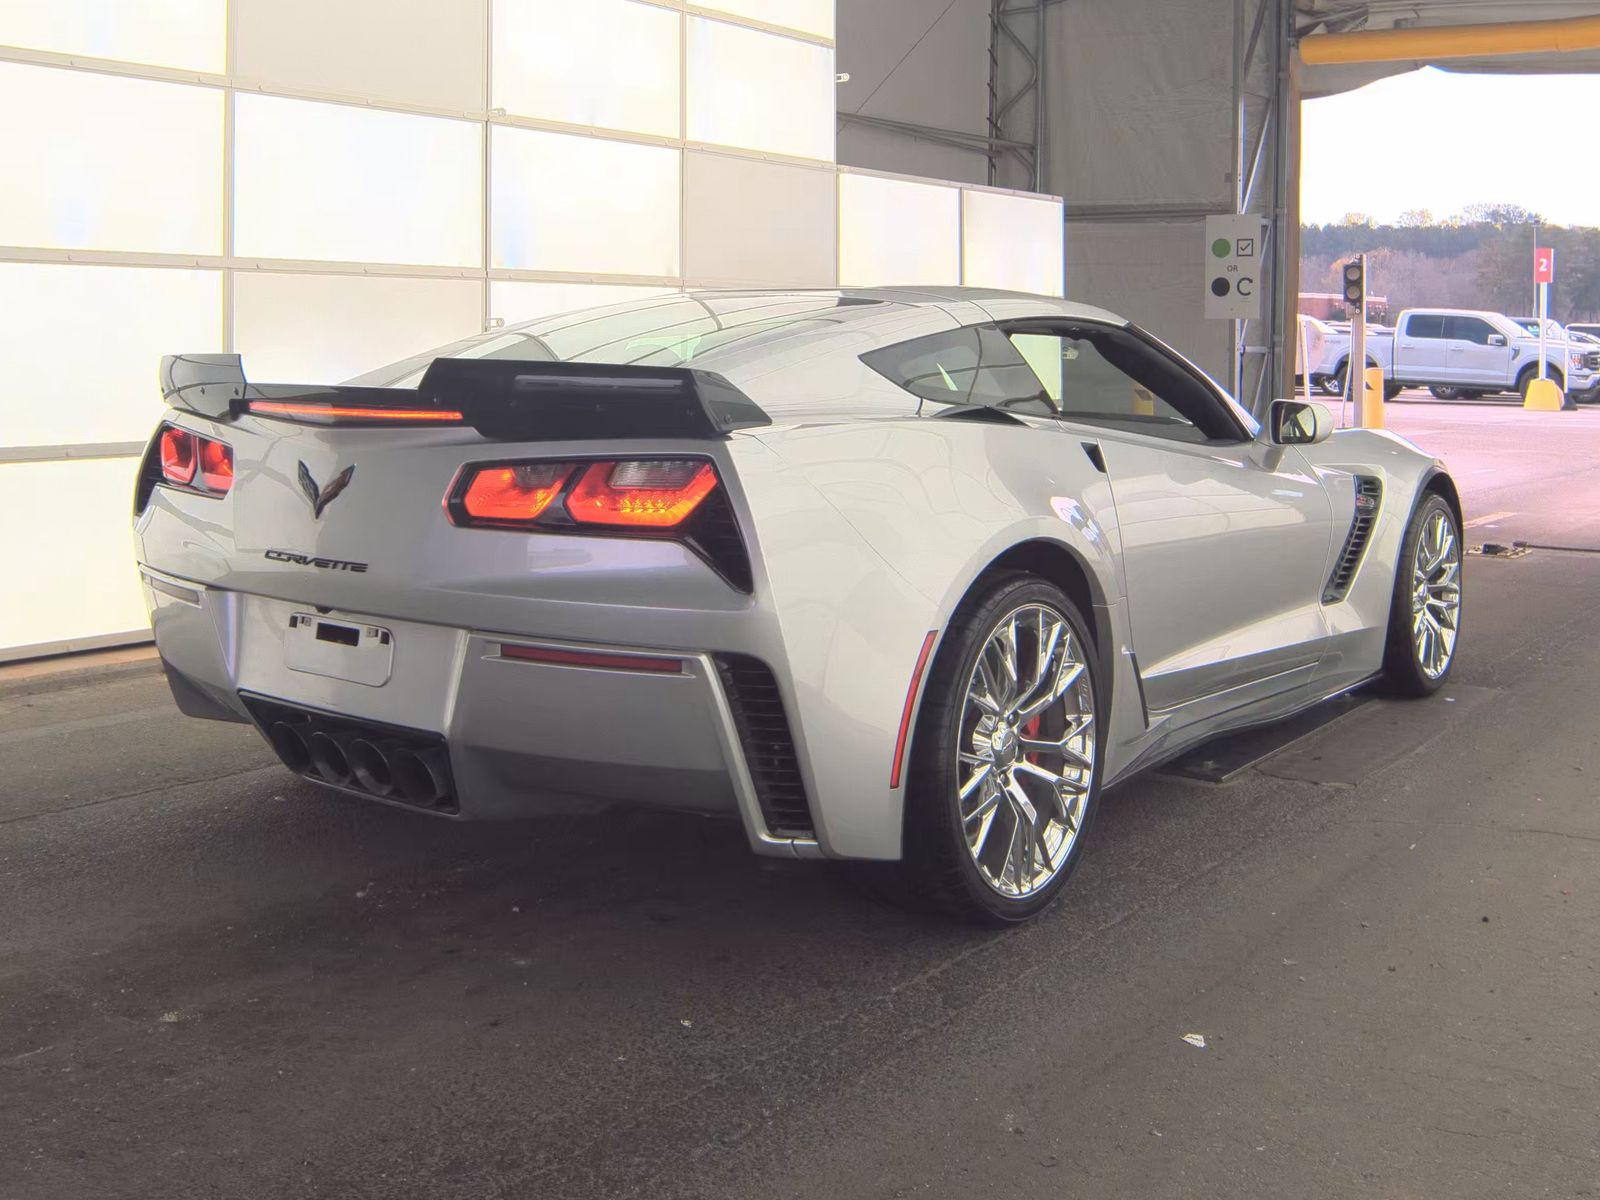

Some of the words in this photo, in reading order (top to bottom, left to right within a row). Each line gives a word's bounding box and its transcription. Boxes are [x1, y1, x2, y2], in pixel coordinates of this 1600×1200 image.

[1226, 264, 1239, 273] OR
[1538, 258, 1548, 272] 2
[264, 549, 369, 573] CORVETTE
